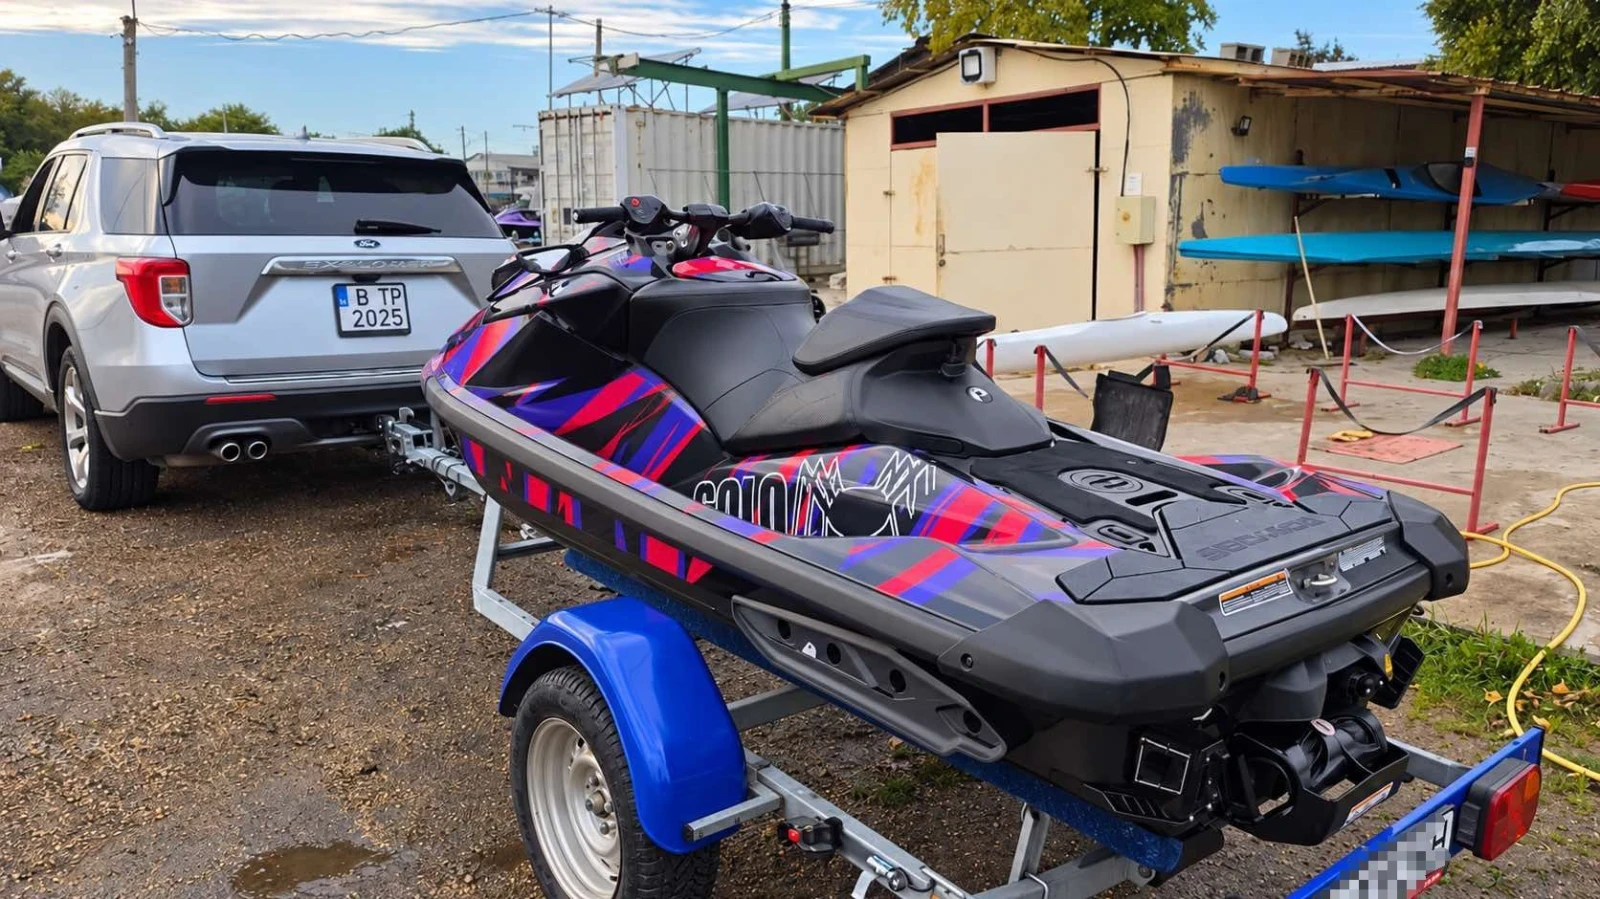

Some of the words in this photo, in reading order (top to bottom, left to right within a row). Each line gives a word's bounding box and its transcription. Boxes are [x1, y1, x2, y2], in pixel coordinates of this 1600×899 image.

[356, 288, 369, 306] B
[378, 288, 401, 305] TP
[352, 308, 403, 328] 2025
